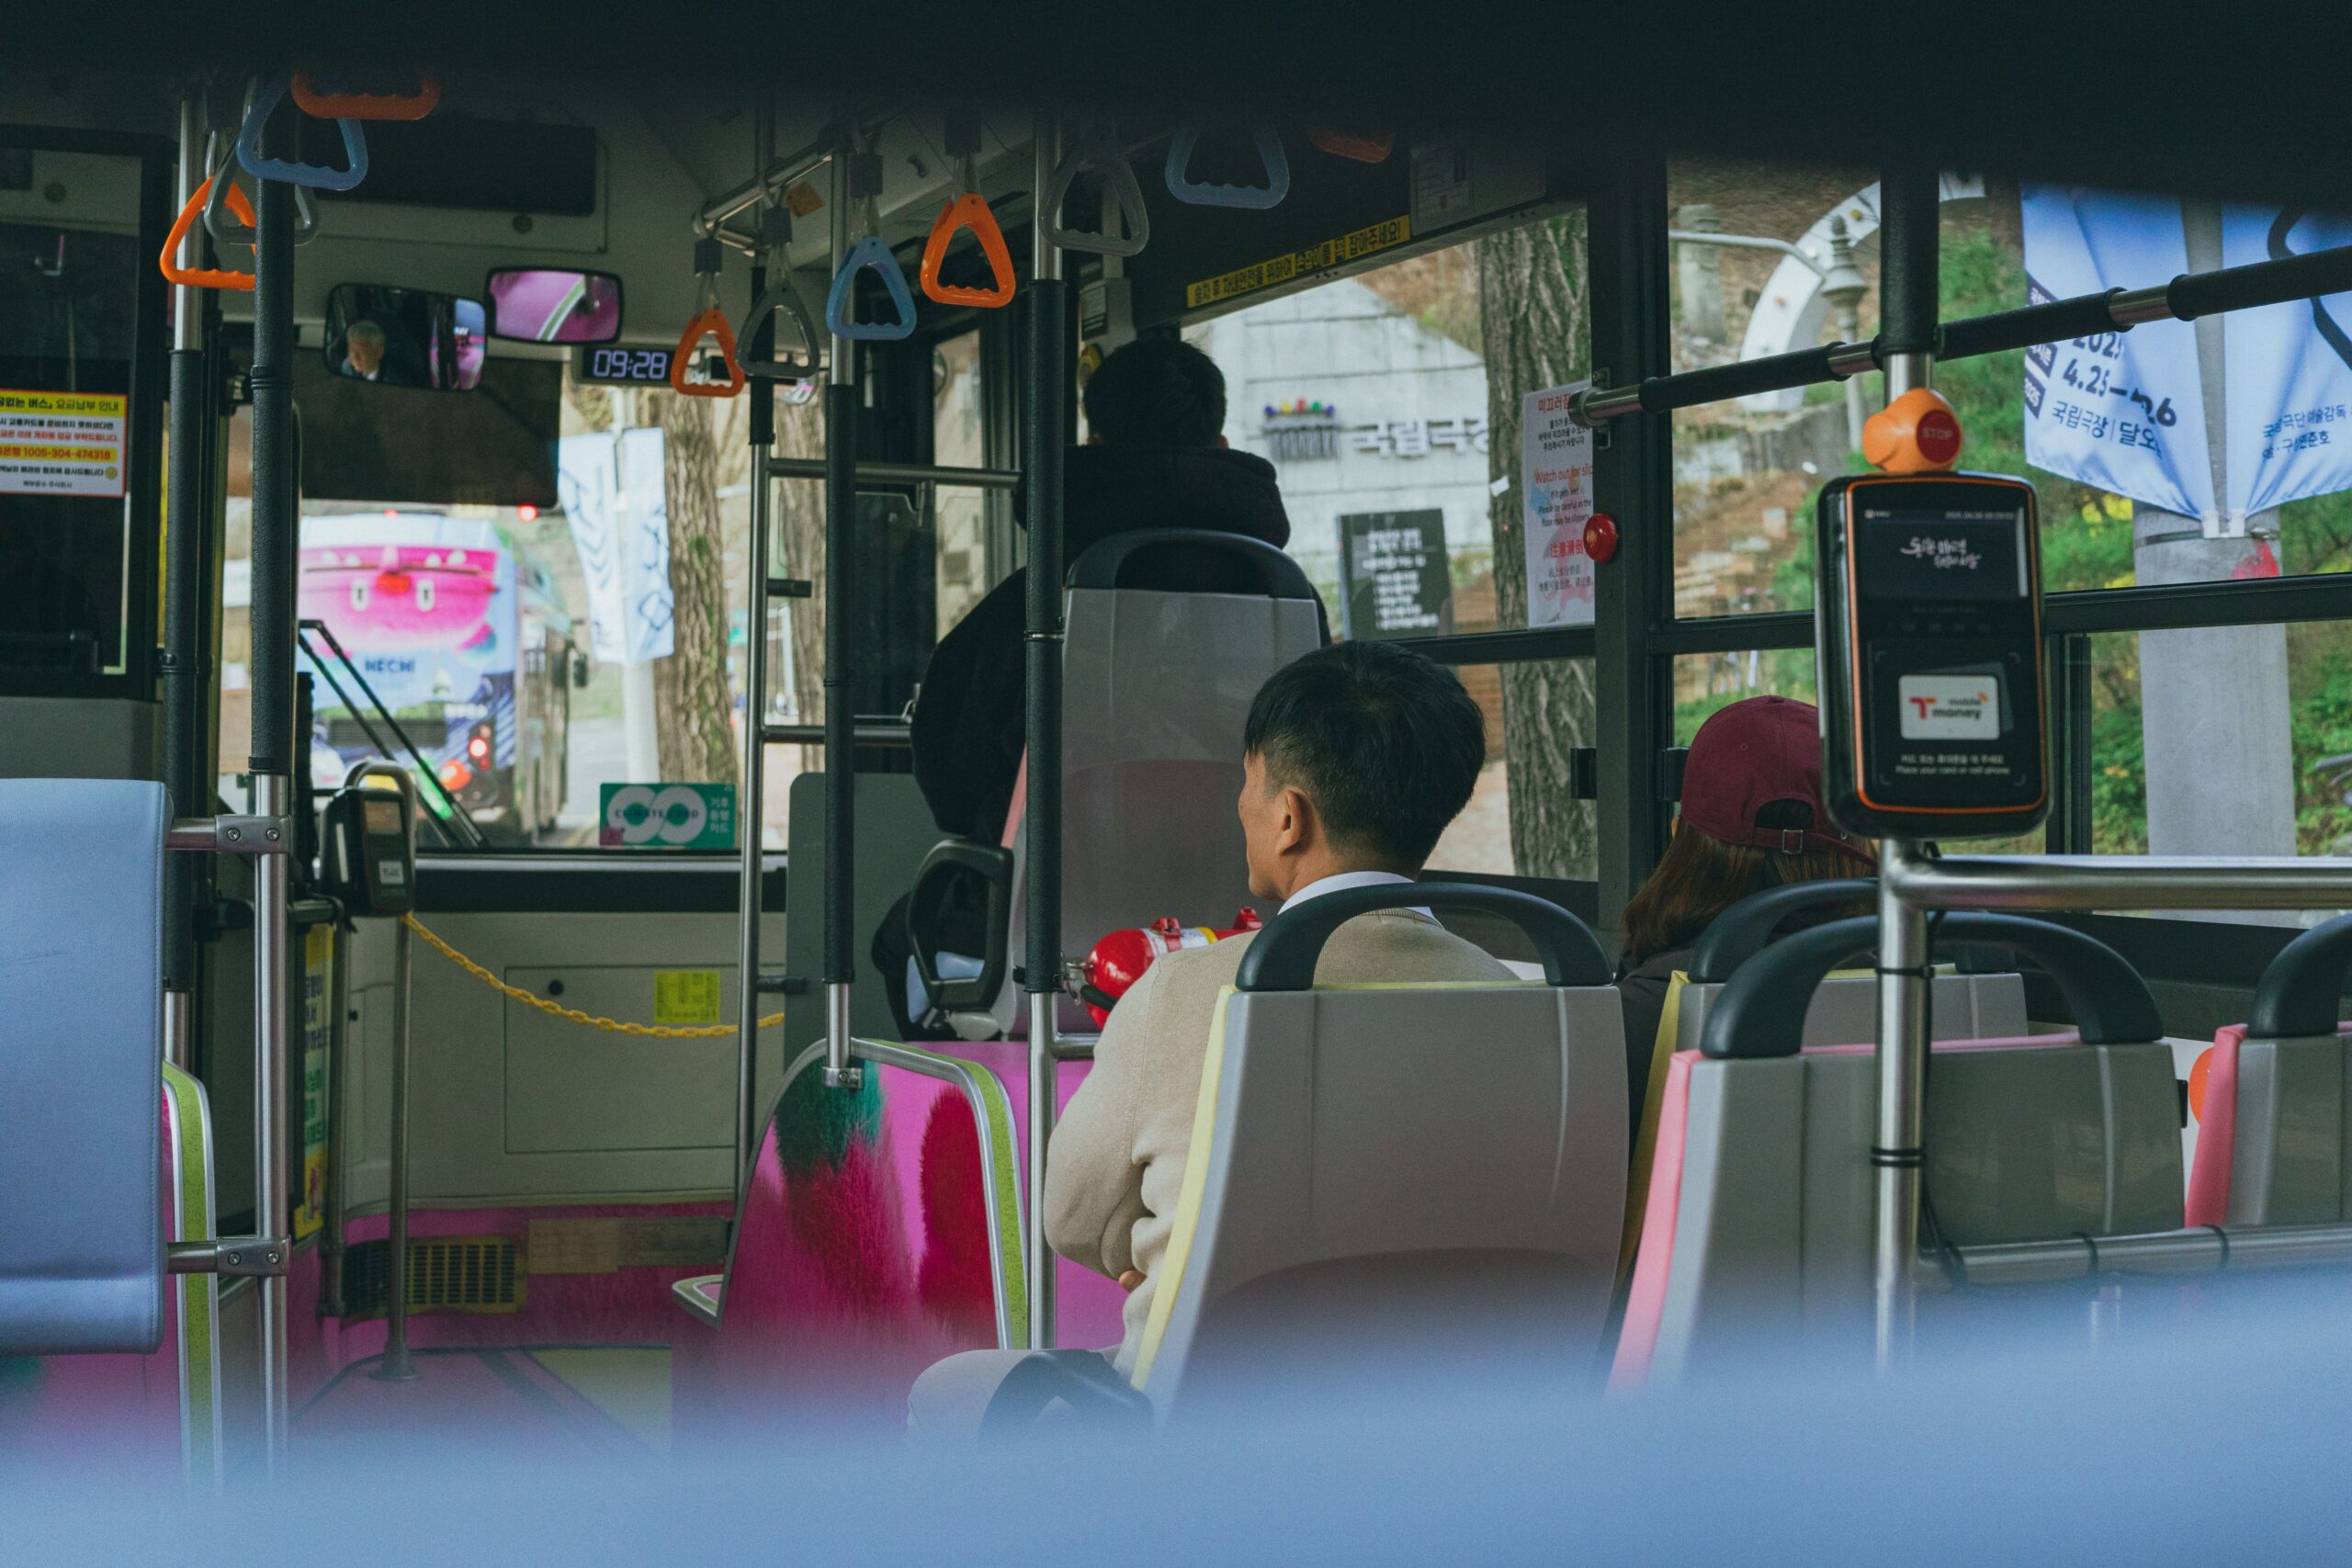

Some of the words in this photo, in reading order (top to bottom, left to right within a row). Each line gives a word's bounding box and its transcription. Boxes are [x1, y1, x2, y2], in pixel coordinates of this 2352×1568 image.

[1349, 221, 1402, 255] 잡아주세요!
[593, 350, 668, 379] 09:28
[56, 399, 96, 411] 요금납부
[98, 401, 119, 412] 안내
[2052, 400, 2109, 438] 국립극장
[1922, 427, 1952, 440] STOP
[0, 446, 21, 456] 은행
[1535, 468, 1556, 484] Watch
[1920, 766, 1936, 774] your
[1939, 766, 1957, 774] card
